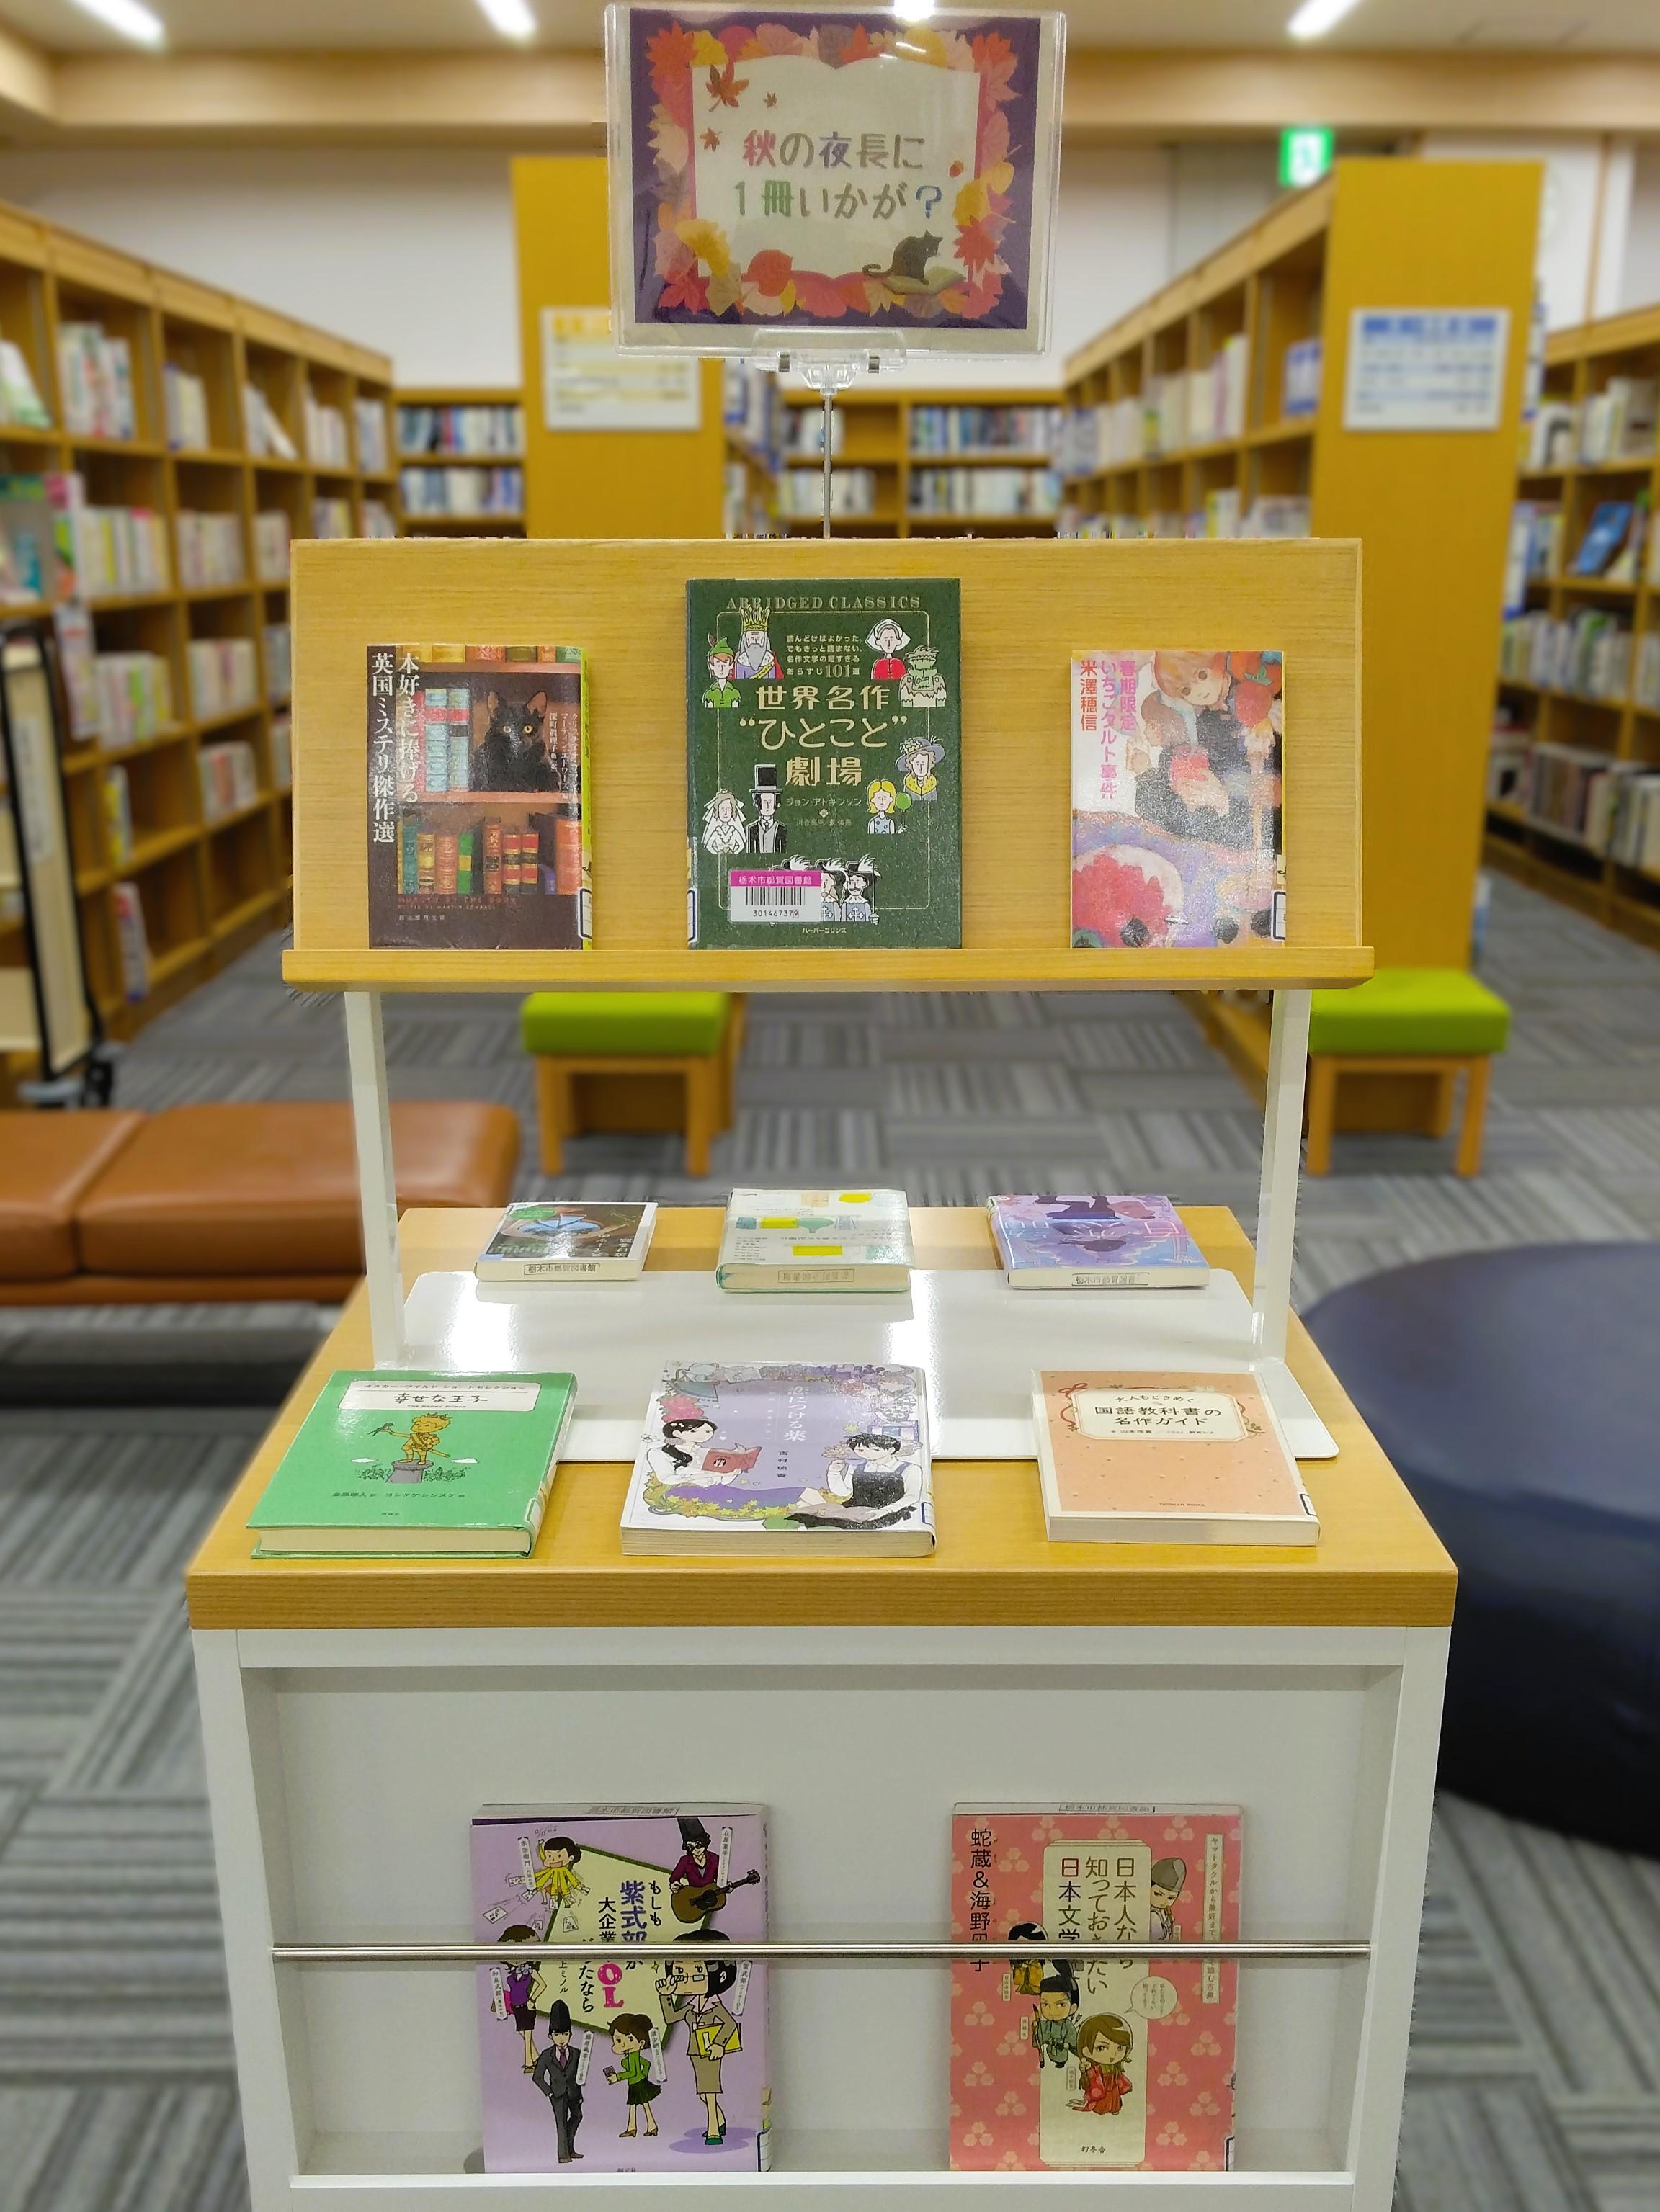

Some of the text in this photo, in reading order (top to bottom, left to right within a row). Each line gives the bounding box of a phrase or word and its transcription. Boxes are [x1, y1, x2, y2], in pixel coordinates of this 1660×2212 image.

[743, 130, 925, 169] 秋の夜長に
[726, 596, 922, 609] ABRIDGED CLASSICS
[755, 685, 891, 711] 世界名作
[1080, 659, 1098, 732] 米澤穂信
[1119, 659, 1137, 731] 春期限定
[398, 653, 420, 803] 本好きに捧げる
[1099, 660, 1118, 799] いちごタルト事件
[371, 653, 396, 843] 英国ミステリ傑作選
[785, 756, 863, 787] 劇場
[738, 875, 813, 885] 栃木市都賀図書館
[752, 910, 799, 918] 301467379
[393, 1392, 488, 1405] 幸せな王子
[1094, 1406, 1222, 1416] 国語教科書の
[1115, 1394, 1194, 1403] 大人もときめく
[1113, 1416, 1208, 1426] 名作ガイド
[648, 1881, 662, 1926] もしも
